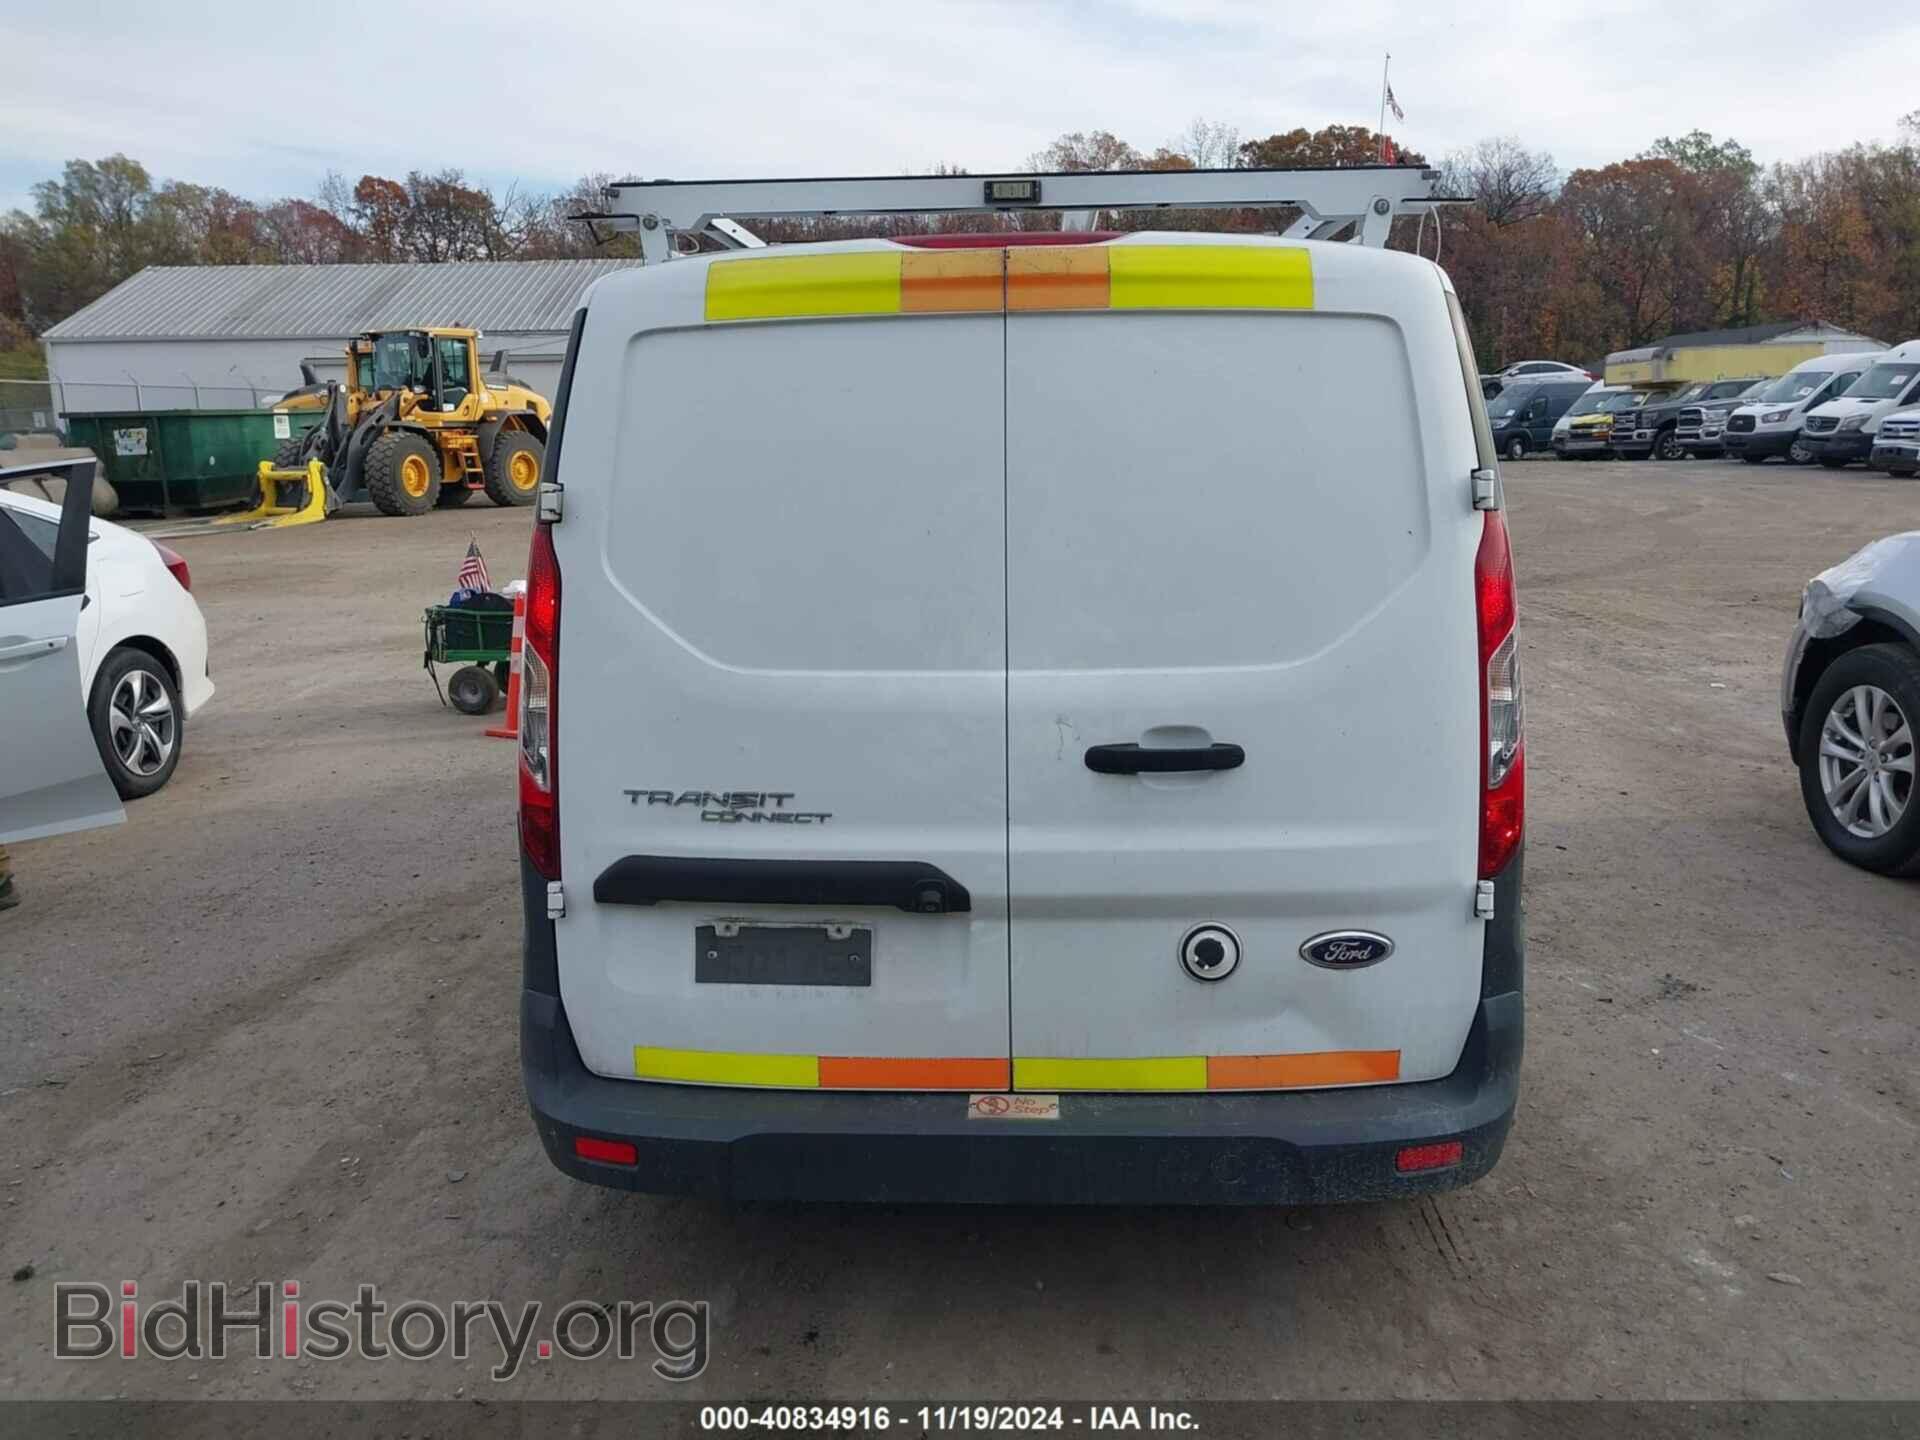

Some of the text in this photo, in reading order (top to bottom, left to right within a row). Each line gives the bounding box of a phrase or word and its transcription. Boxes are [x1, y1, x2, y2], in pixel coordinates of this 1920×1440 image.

[623, 790, 795, 808] TRANSIT
[701, 811, 833, 824] CONNECT
[1324, 941, 1373, 961] Ford
